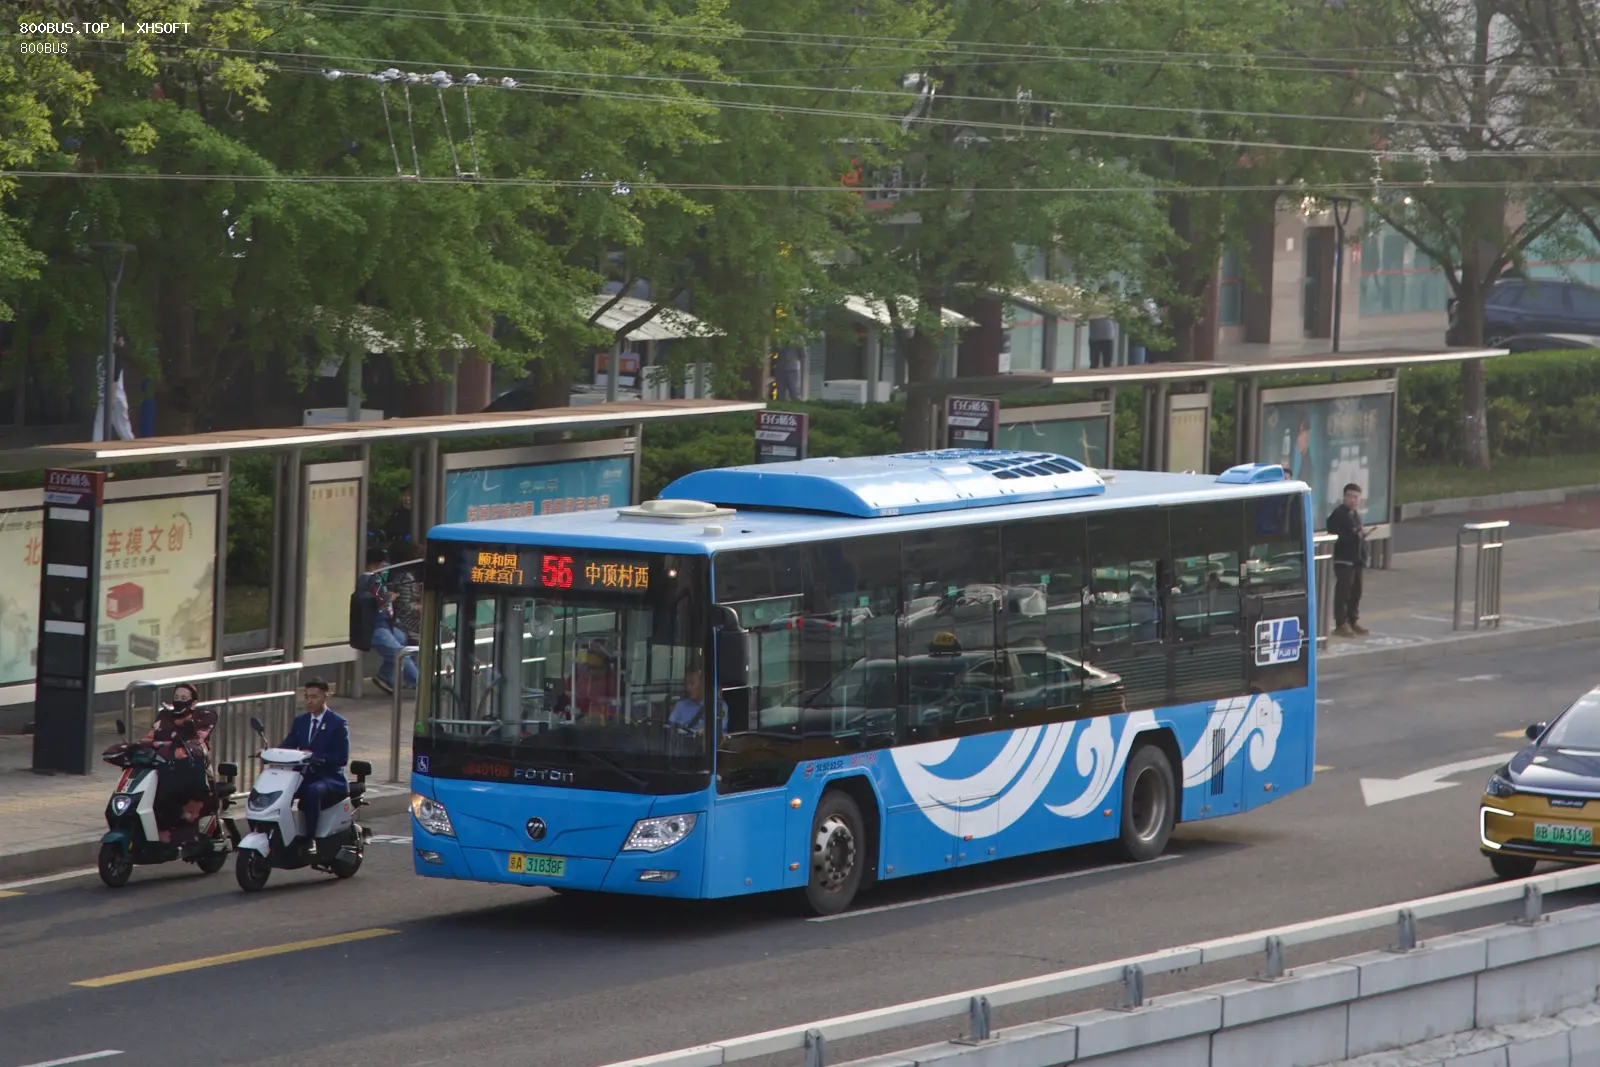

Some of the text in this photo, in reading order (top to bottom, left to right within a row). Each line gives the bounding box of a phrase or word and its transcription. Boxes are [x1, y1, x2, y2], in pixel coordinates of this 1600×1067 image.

[104, 523, 186, 558] 车模文创
[478, 552, 517, 569] 颐和园
[470, 567, 524, 585] 新建宫门
[541, 554, 574, 588] 56
[585, 562, 650, 588] 中顶村西
[513, 768, 575, 782] FOTON
[526, 857, 564, 874] 31838F
